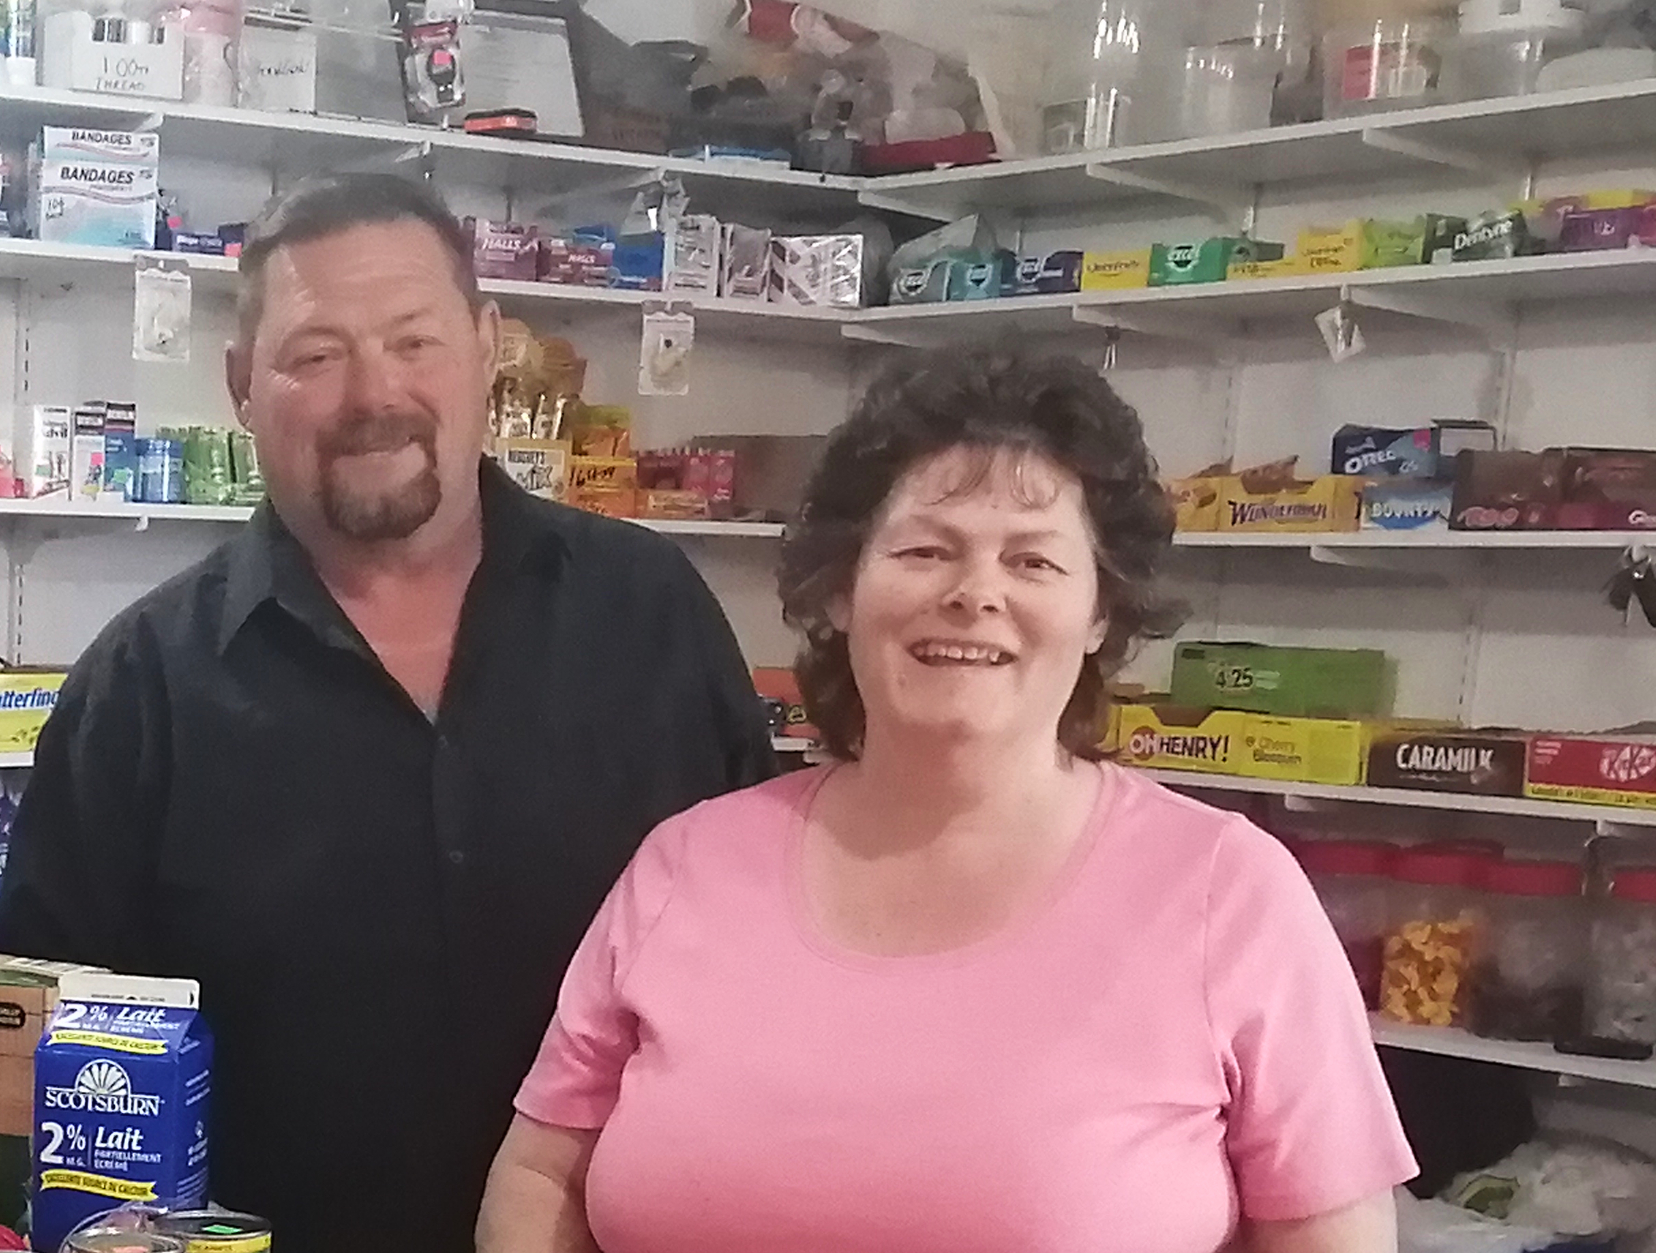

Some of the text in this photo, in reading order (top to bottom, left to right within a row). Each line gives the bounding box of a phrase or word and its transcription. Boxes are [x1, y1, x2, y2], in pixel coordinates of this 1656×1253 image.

[71, 130, 133, 146] BANDAGES
[60, 166, 135, 185] BANDAGES
[482, 237, 522, 250] HALLS
[1453, 218, 1514, 252] Dentyne
[1370, 501, 1435, 519] BOUNTY
[1396, 743, 1495, 773] CARAMILK
[116, 1006, 167, 1023] Lait
[45, 1089, 161, 1117] SCOTSBURN
[94, 1124, 145, 1151] Lait
[94, 1148, 163, 1165] PARTIELLEMENT
